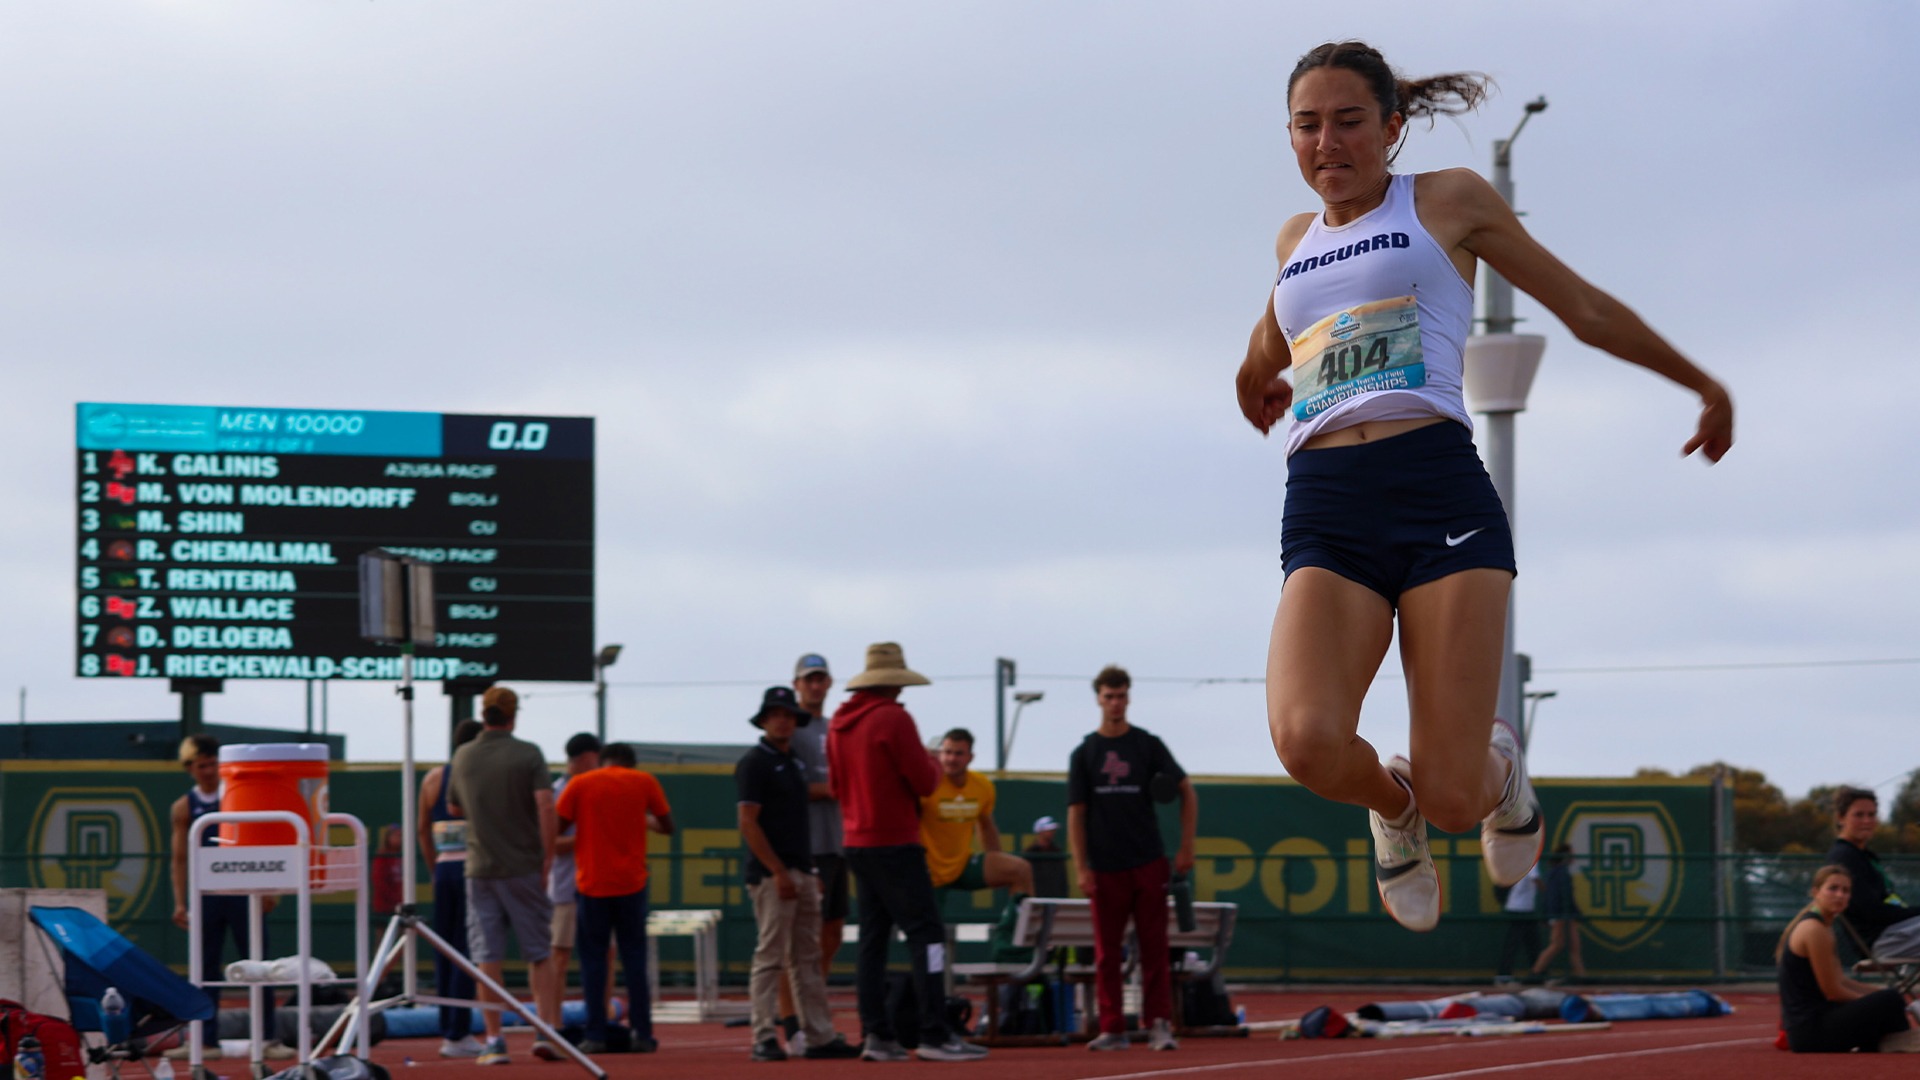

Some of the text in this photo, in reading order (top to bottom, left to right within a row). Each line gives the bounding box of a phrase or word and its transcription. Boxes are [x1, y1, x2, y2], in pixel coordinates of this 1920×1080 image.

[1317, 336, 1389, 386] 404
[1356, 376, 1376, 387] Track
[1385, 369, 1405, 379] Field
[1305, 376, 1408, 415] CHAMPIONSHIPS
[220, 413, 278, 430] MEN
[286, 414, 364, 434] 10000
[488, 422, 549, 450] 0.0
[83, 453, 98, 474] 1
[137, 454, 166, 475] K.
[172, 454, 280, 477] GALINIS
[384, 462, 444, 477] AZUSA
[82, 482, 99, 502] 2
[137, 483, 171, 503] M.
[178, 483, 234, 504] VON
[241, 485, 416, 507] MOLENDORFF
[82, 509, 243, 533] 3 M. SHIN
[469, 520, 497, 535] CU
[81, 539, 338, 564] 4 R. CHEMALMAL
[81, 567, 296, 591] 5 T. RENTERIA
[469, 577, 497, 592] CU
[81, 596, 99, 617] 6
[136, 597, 163, 618] Z.
[170, 598, 295, 620] WALLACE
[81, 625, 293, 648] 7 D. DELOERA
[81, 654, 100, 676] 8
[137, 655, 159, 676] J.
[166, 655, 461, 679] RIECKEWALD-SCHMIDT
[210, 860, 286, 873] GATORADE
[1194, 836, 1505, 915] POIT
